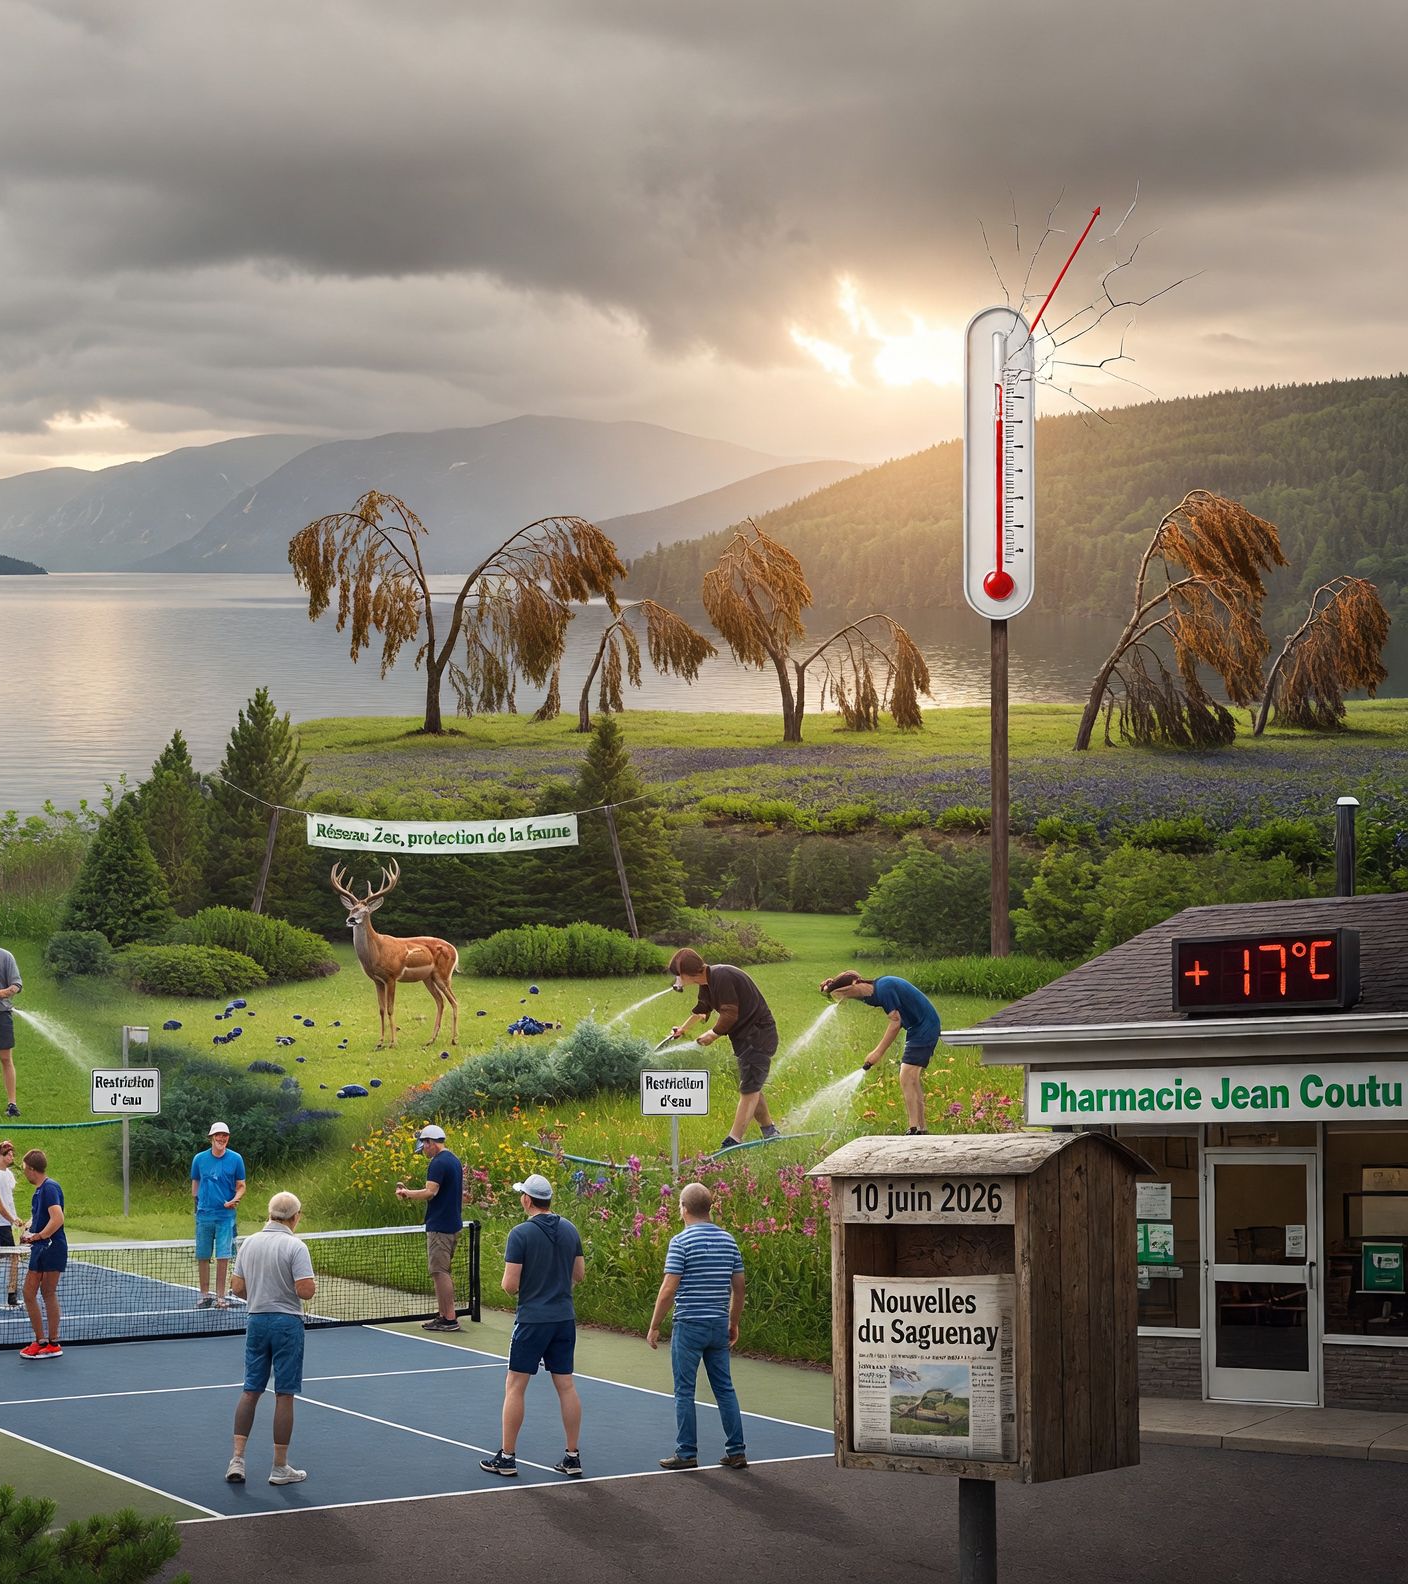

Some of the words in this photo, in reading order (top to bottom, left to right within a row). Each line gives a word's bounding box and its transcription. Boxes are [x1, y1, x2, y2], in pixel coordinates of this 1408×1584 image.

[407, 829, 484, 848] protection
[487, 826, 506, 843] de
[510, 827, 523, 842] la
[527, 824, 572, 841] faune
[1040, 1078, 1202, 1113] Pharmacie
[1211, 1077, 1289, 1110] Jean
[1299, 1074, 1403, 1109] Coutu
[851, 1183, 879, 1212] 10
[885, 1183, 932, 1220] juin
[941, 1182, 1003, 1213] 2026
[870, 1288, 977, 1314] Nouvelles
[858, 1318, 884, 1343] du
[890, 1318, 1000, 1351] Saguenay
